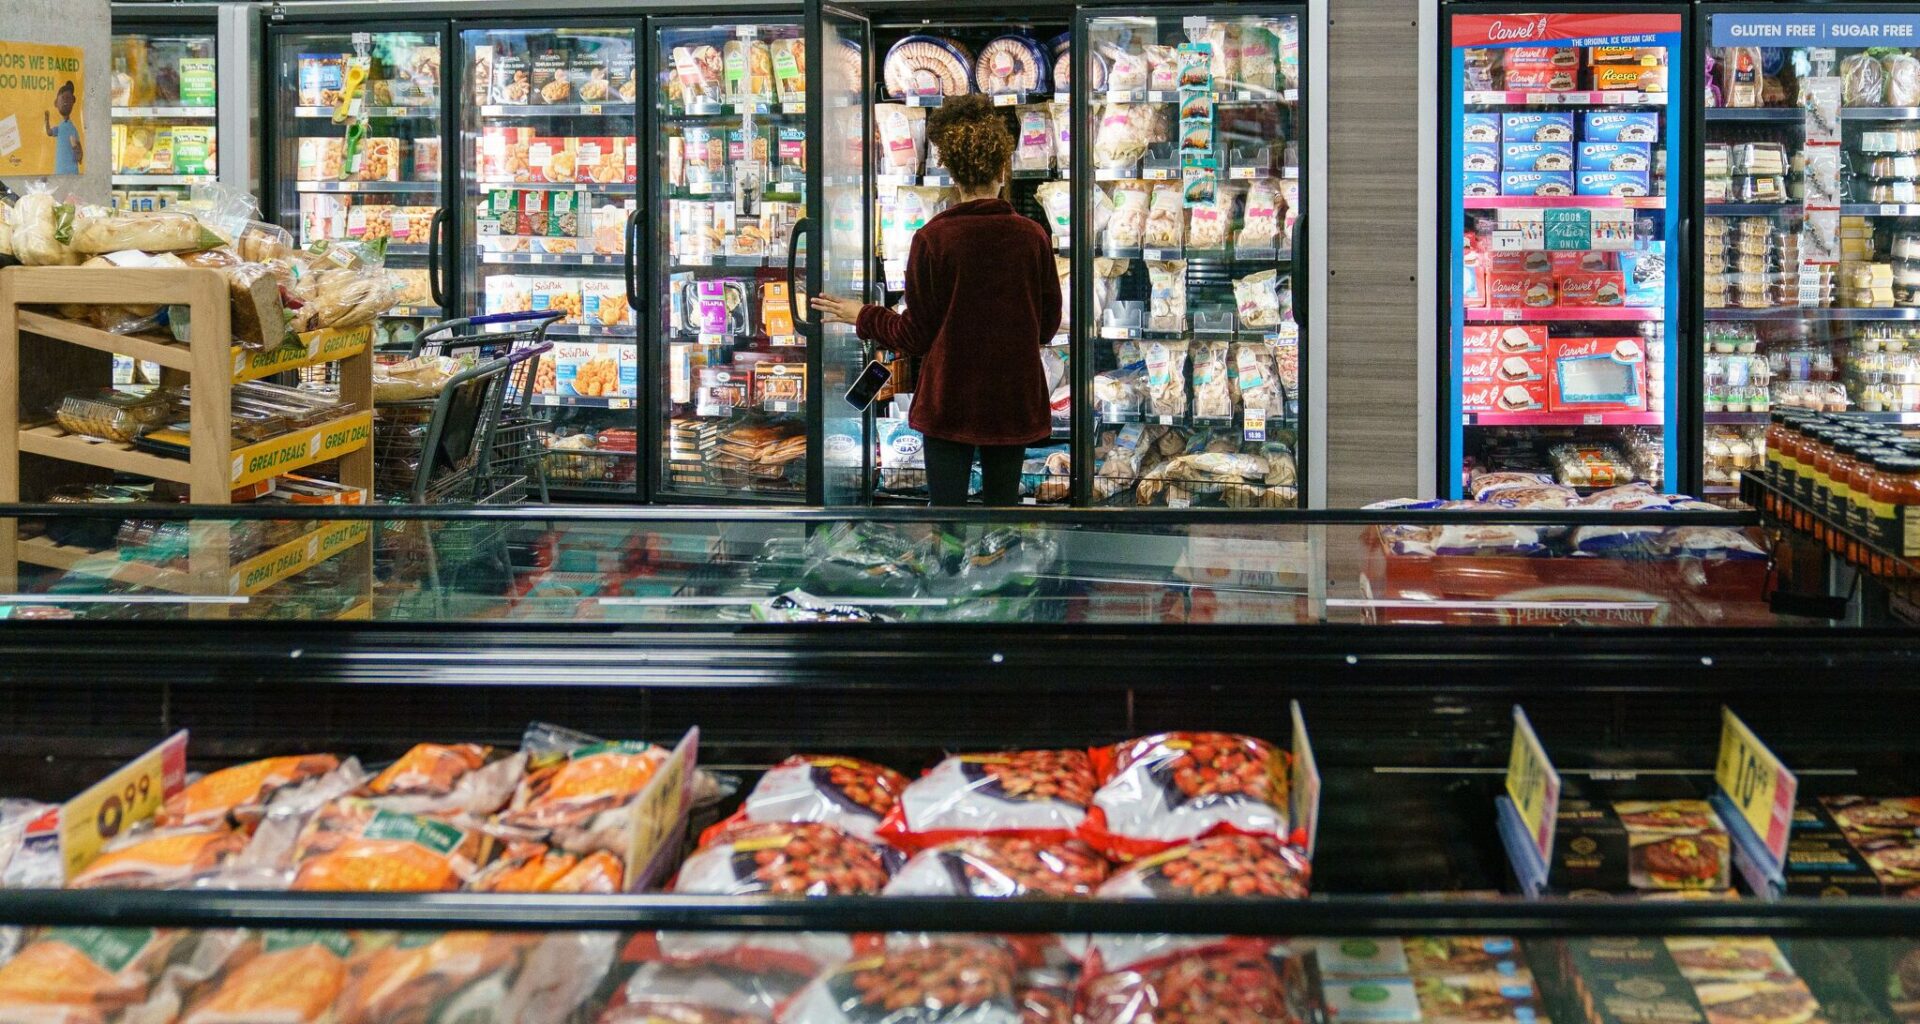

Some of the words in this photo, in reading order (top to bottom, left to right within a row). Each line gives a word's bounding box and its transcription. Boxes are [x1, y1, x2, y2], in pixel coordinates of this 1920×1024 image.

[1488, 20, 1533, 40] Carvel
[1730, 24, 1782, 37] GLUTEN
[1786, 24, 1816, 37] FREE
[1831, 24, 1879, 37] SUGAR
[1883, 24, 1913, 37] FREE
[1572, 38, 1583, 46] THE
[1583, 36, 1609, 46] ORIGINAL
[1611, 35, 1620, 44] ICE
[1620, 34, 1641, 43] CREAM
[1642, 33, 1656, 43] CAKE
[28, 55, 44, 70] WE
[48, 57, 80, 72] BAKED
[1510, 71, 1538, 83] Carvel
[1602, 68, 1638, 81] Reese's
[21, 74, 54, 91] MUCH
[1507, 115, 1541, 127] OREO
[1591, 115, 1626, 127] OREO
[1507, 144, 1541, 156] OREO
[1583, 144, 1618, 156] OREO
[1506, 174, 1541, 186] OREO
[1581, 173, 1616, 185] OREO
[1559, 212, 1581, 222] GOOD
[1560, 239, 1580, 249] ONLY
[534, 281, 562, 291] SeaPak
[584, 282, 609, 291] SeaPak
[1491, 278, 1522, 293] Carvel
[1562, 278, 1592, 293] Carvel
[323, 333, 349, 353] GREAT
[559, 347, 590, 359] SeaPak
[1559, 343, 1590, 357] Carvel
[252, 350, 282, 369] GREAT
[325, 430, 349, 450] GREAT
[900, 445, 918, 453] BAY
[249, 452, 277, 473] GREAT
[279, 443, 306, 465] DEALS
[323, 526, 348, 550] GREAT
[245, 564, 275, 588] GREAT
[276, 548, 303, 574] DEALS
[1606, 608, 1644, 625] FARM
